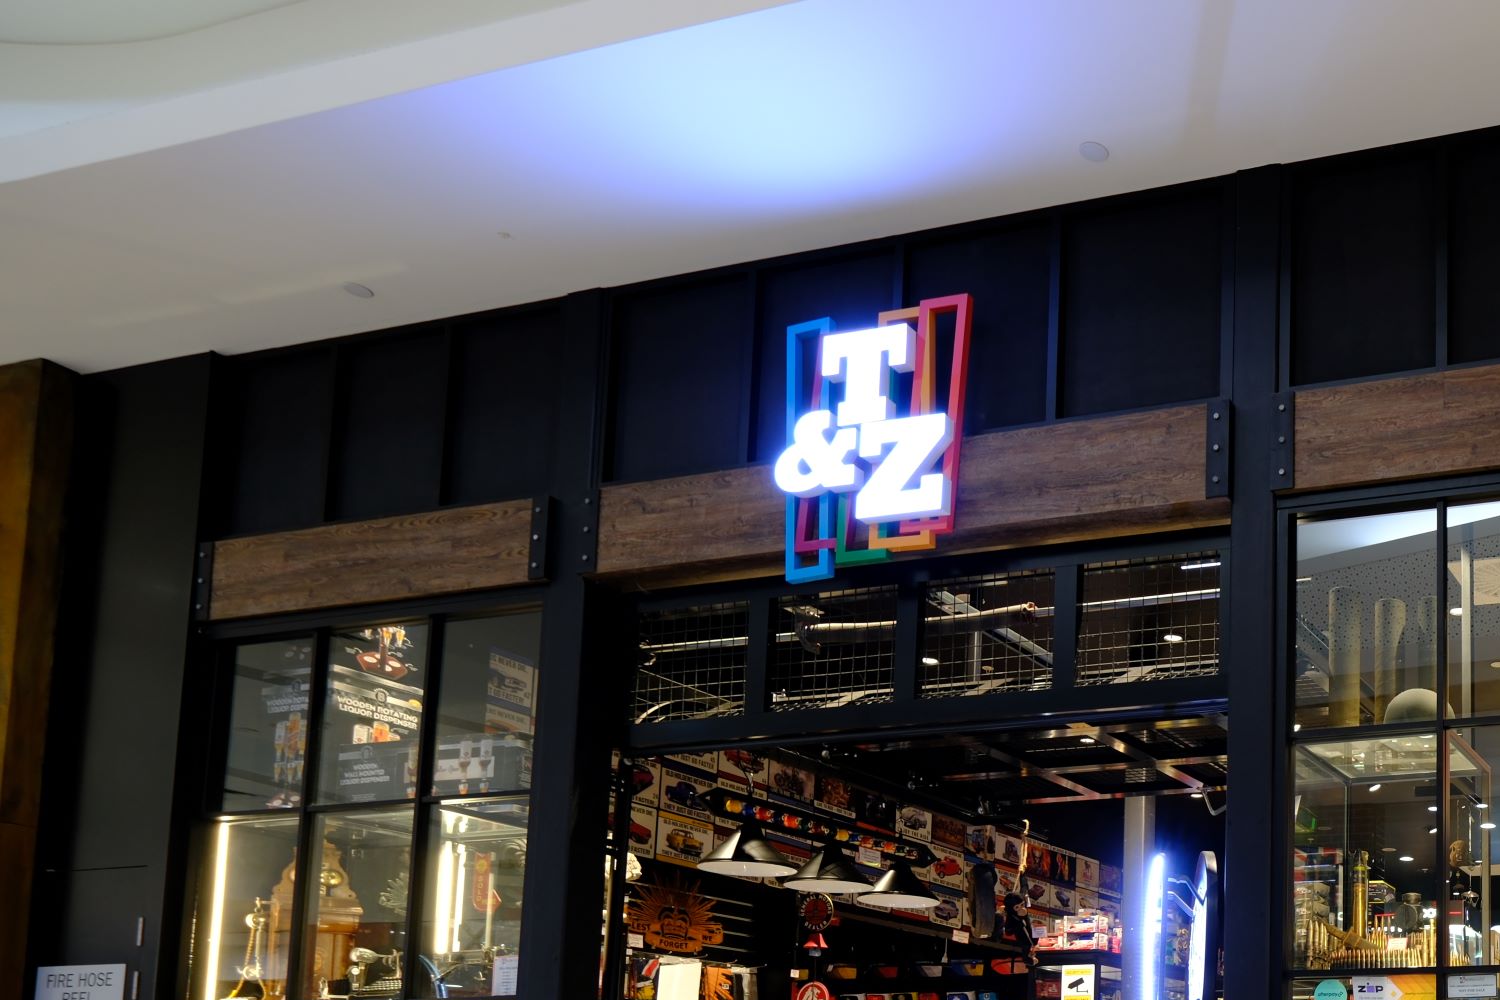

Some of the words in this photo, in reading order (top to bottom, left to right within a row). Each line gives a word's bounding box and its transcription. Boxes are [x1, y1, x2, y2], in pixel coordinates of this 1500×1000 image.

[337, 695, 376, 712] WOODEN
[377, 705, 418, 723] ROTATING
[338, 703, 373, 718] LIQUOR
[373, 712, 418, 731] DISPENSER
[631, 922, 651, 931] LEST
[803, 919, 828, 931] DEALER
[658, 938, 689, 950] FORGET
[46, 973, 75, 988] FIRE
[78, 971, 114, 987] HOSE
